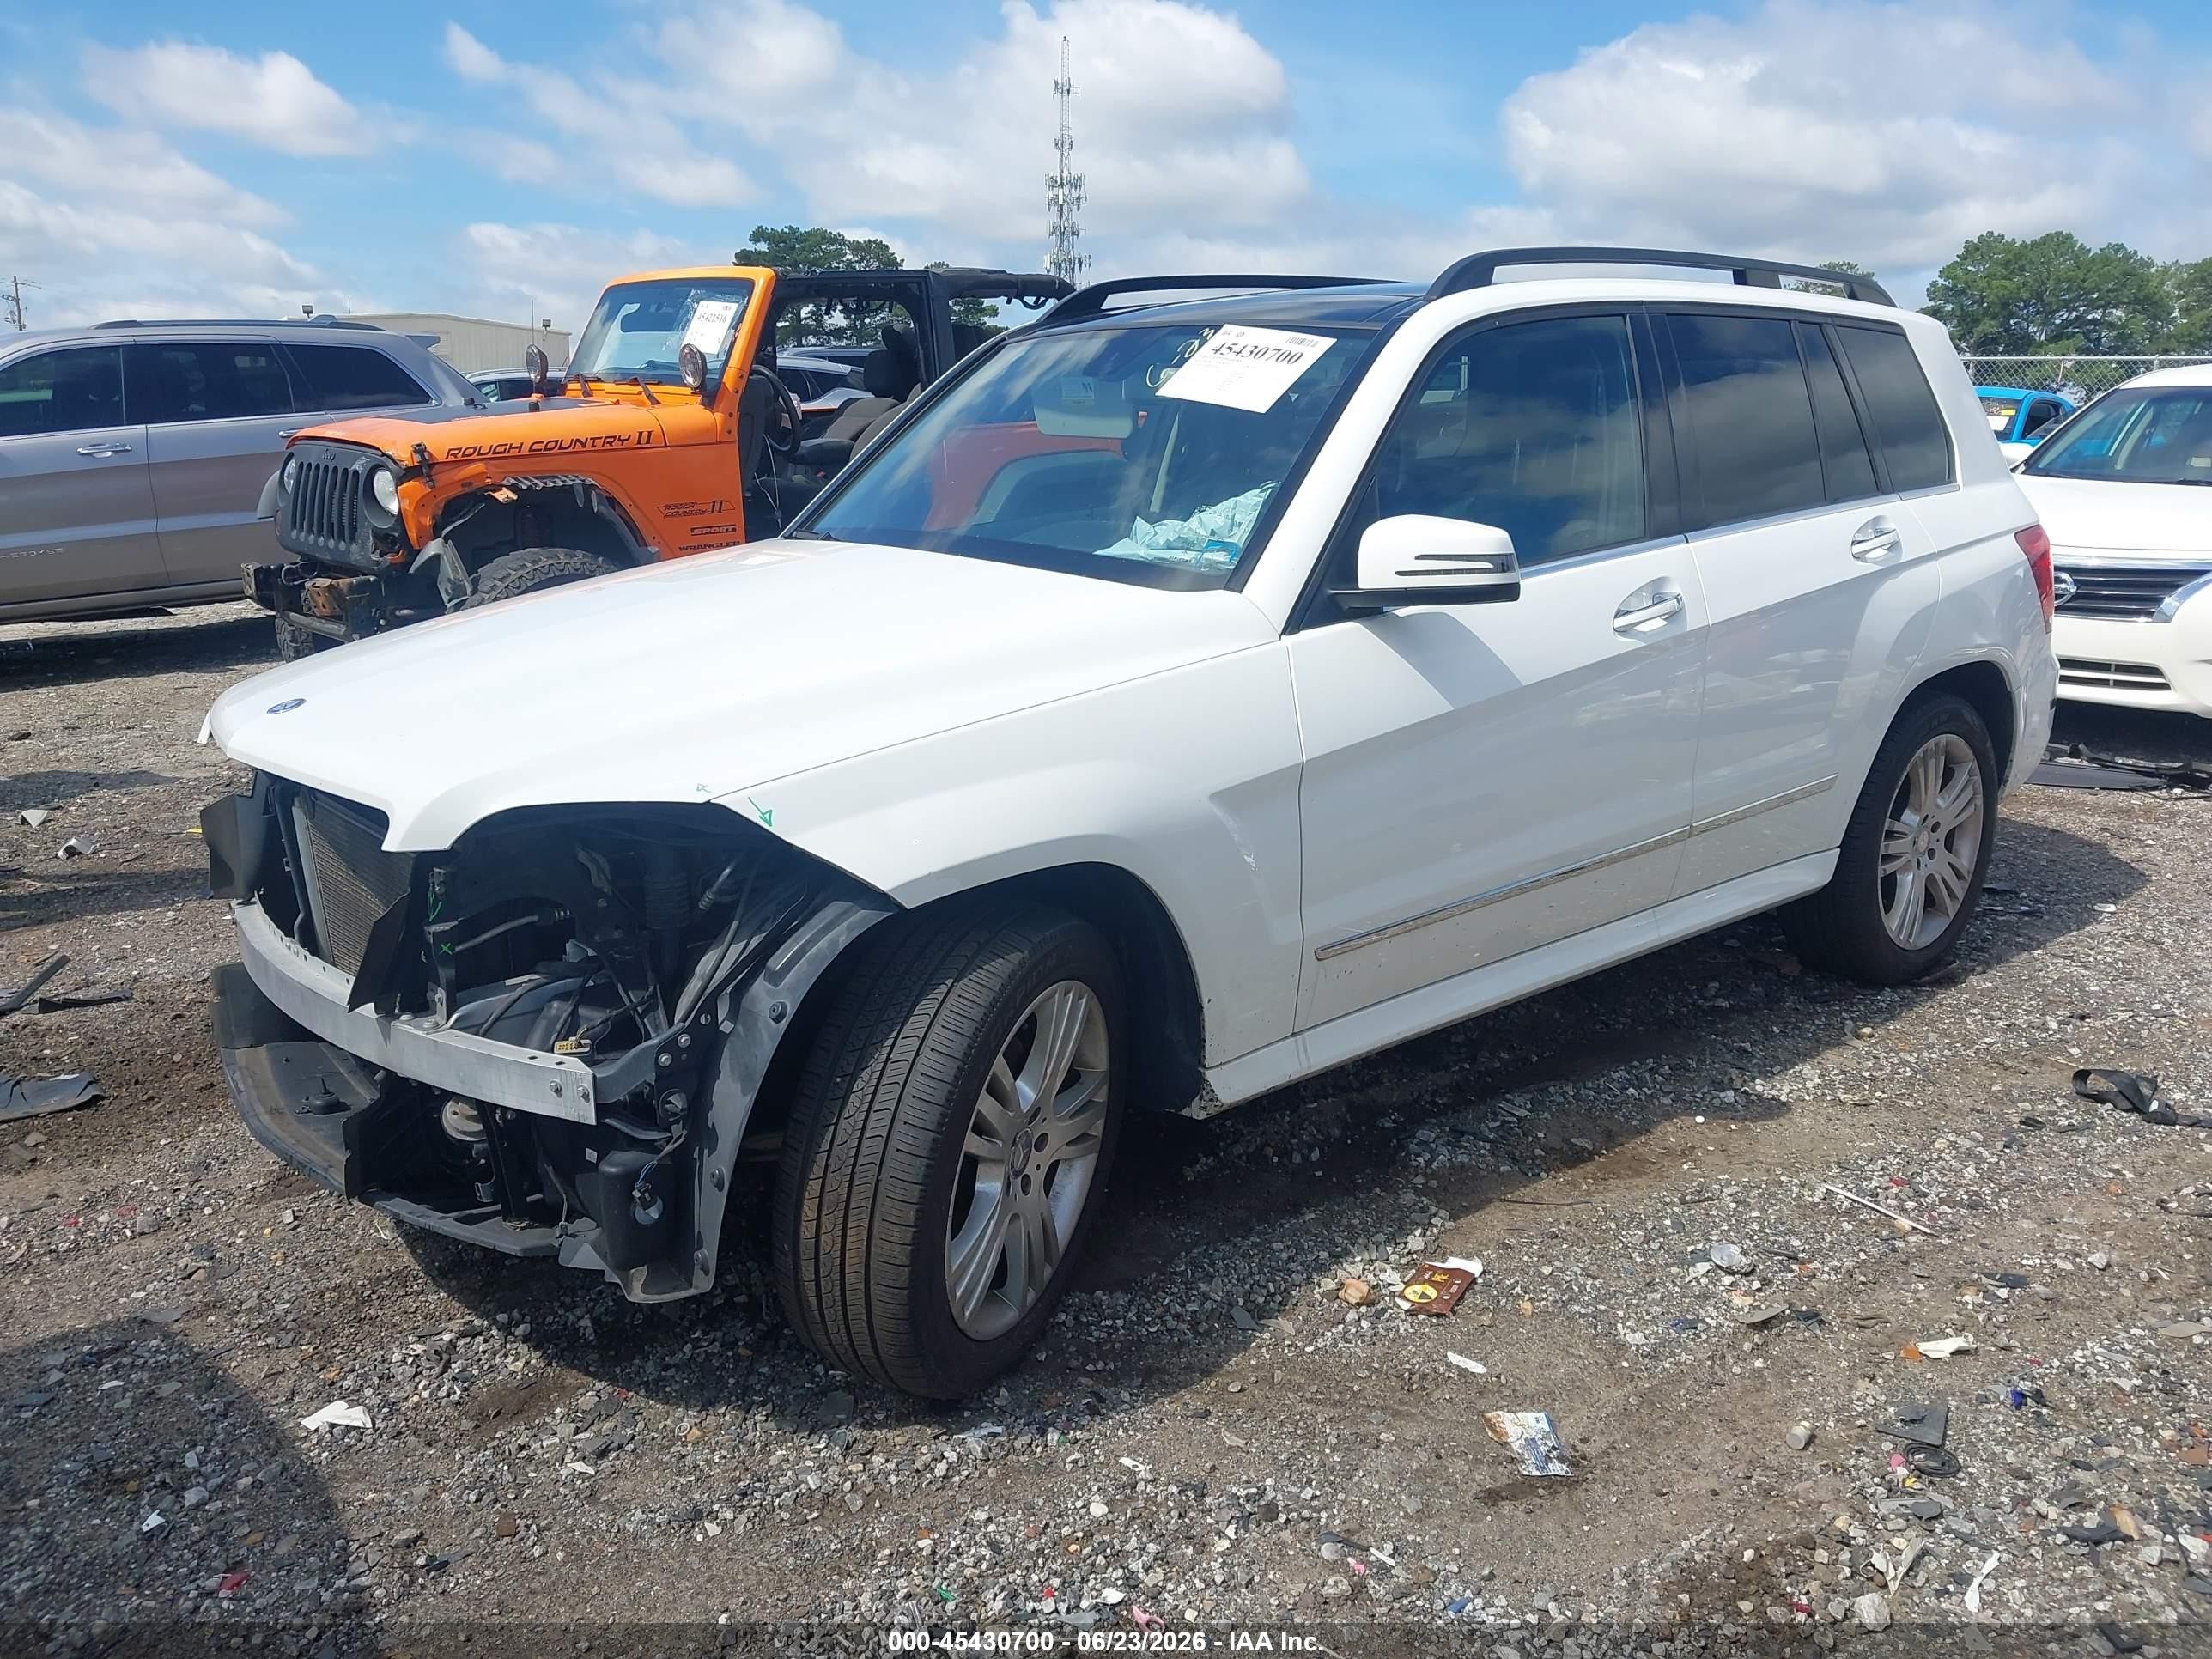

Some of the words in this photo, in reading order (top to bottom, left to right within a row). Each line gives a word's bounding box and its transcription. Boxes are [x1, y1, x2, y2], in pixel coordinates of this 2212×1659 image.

[1212, 342, 1304, 364] 45430700
[445, 442, 524, 459] ROUGH
[527, 434, 632, 453] COUNTRY
[635, 430, 654, 446] II
[678, 540, 740, 551] WRANGLER
